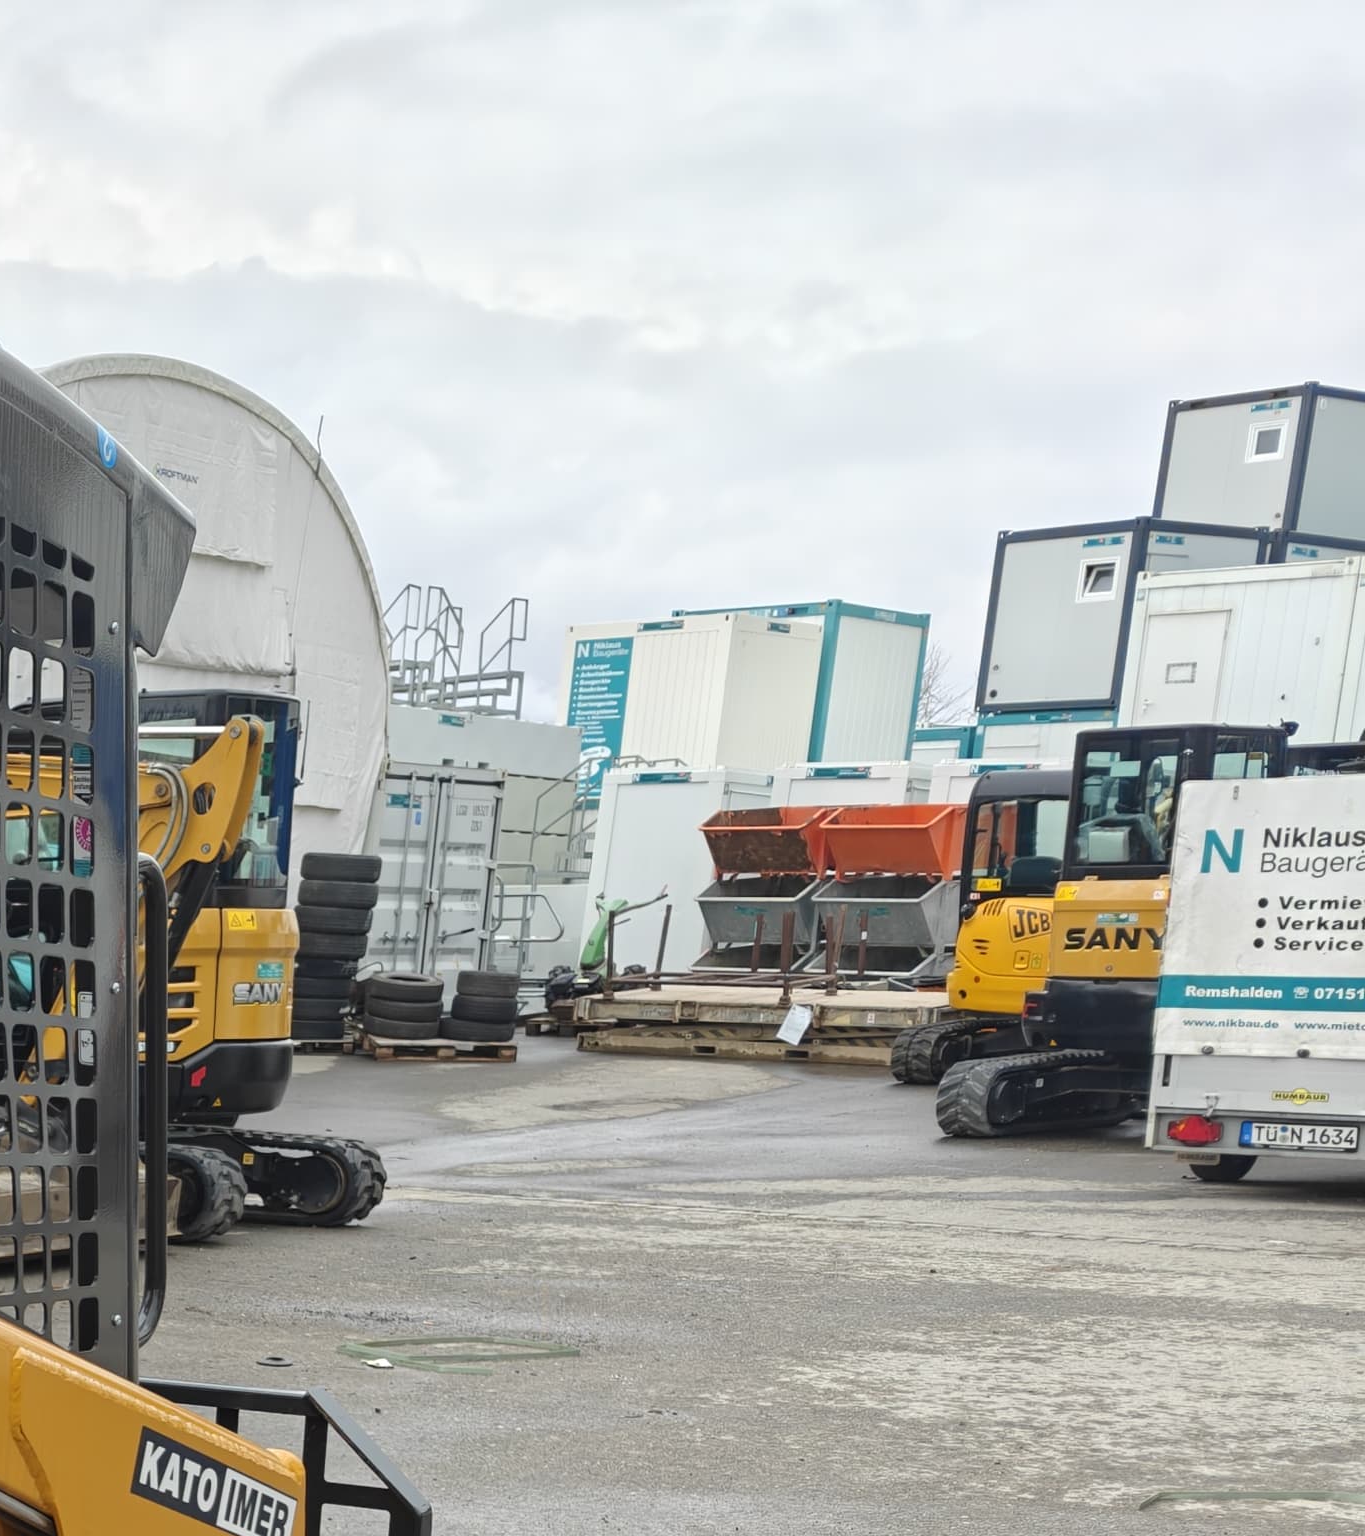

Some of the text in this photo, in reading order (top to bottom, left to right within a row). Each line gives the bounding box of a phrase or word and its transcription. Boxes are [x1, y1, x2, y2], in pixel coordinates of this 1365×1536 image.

[577, 642, 590, 658] N
[1263, 827, 1365, 849] Niklaus
[1200, 828, 1245, 873] N
[1012, 908, 1052, 939] JCB
[1064, 927, 1167, 951] SANY
[1274, 936, 1364, 952] Service
[233, 982, 285, 1005] SANY
[1185, 985, 1364, 1001] Remshalden 07151
[1183, 1017, 1280, 1030] www.nikbau.de
[1255, 1125, 1278, 1143] TÜ
[1307, 1128, 1355, 1146] 1634
[139, 1440, 219, 1513] KATO
